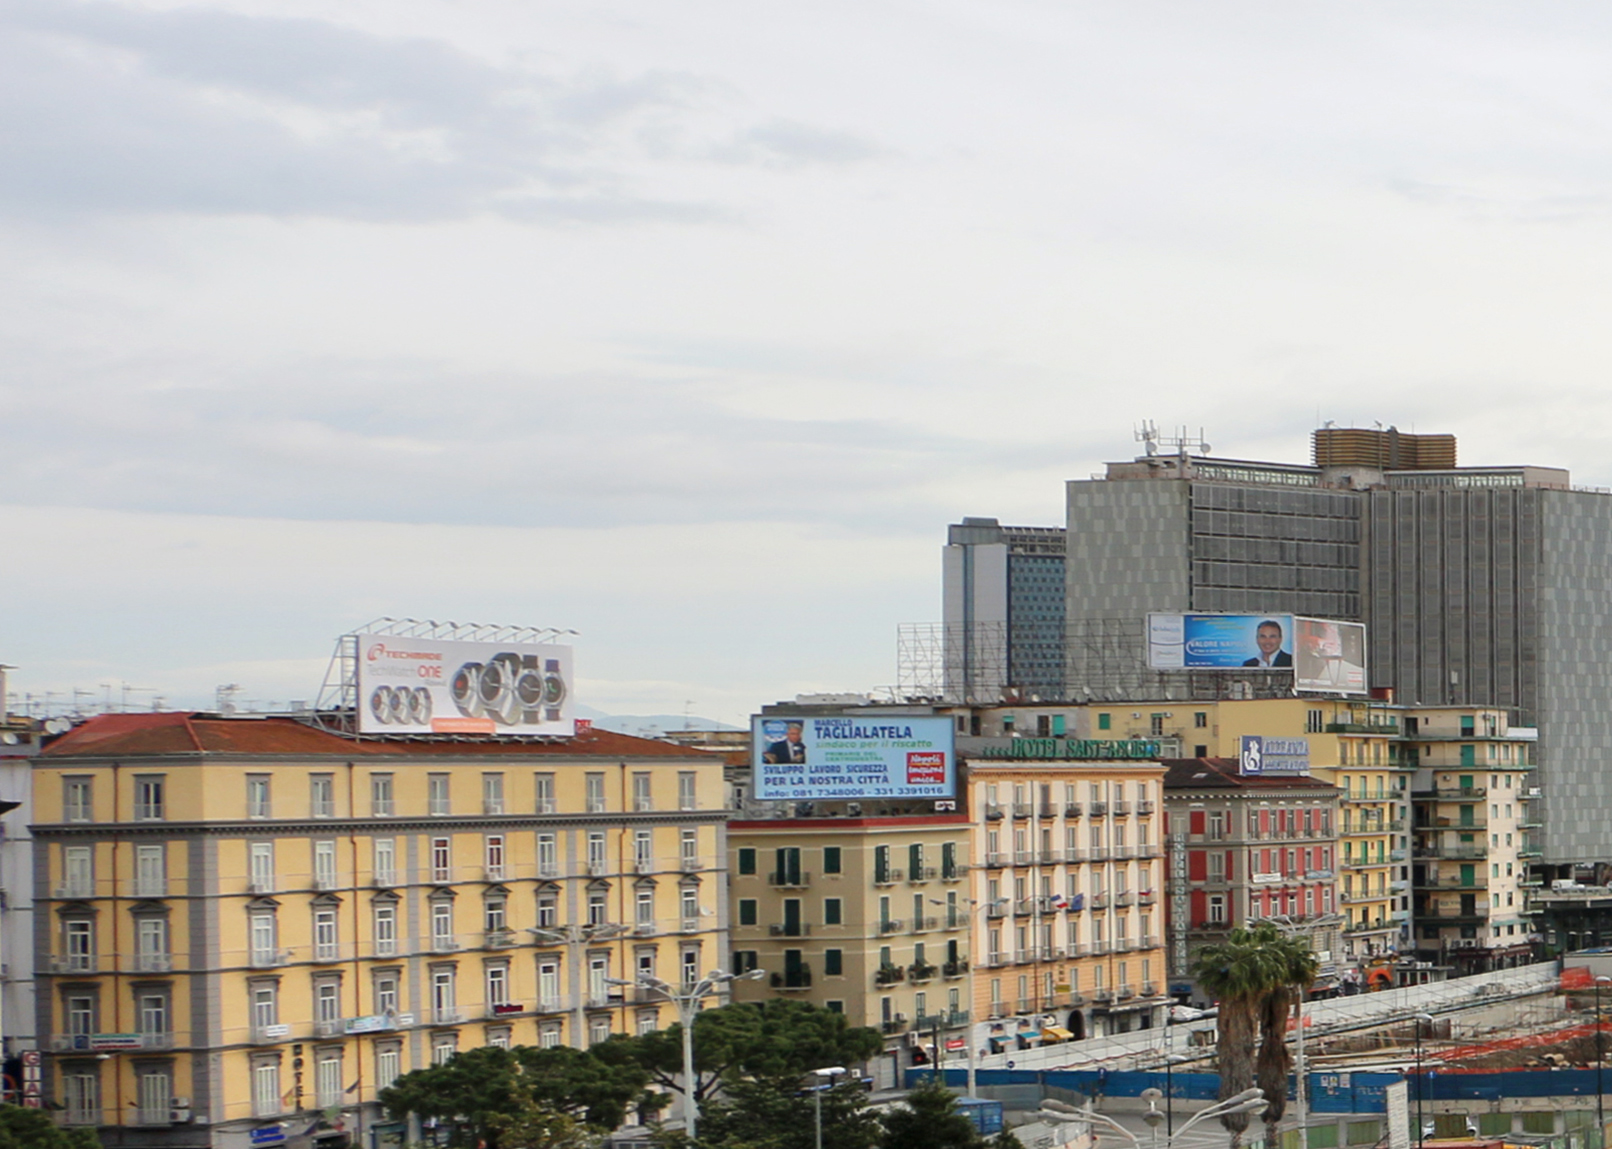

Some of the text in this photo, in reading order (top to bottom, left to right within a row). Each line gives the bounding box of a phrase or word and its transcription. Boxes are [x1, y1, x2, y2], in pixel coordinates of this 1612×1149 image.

[814, 726, 912, 739] TAGLIALATELA
[816, 741, 857, 749] sindaco
[860, 741, 878, 750] per
[891, 739, 933, 748] riscatto
[1012, 738, 1057, 758] HOTEL
[764, 764, 888, 775] SVILUPPO LAVORO SICUREZZA
[764, 773, 889, 786] PER LA NOSTRA CITTÀ
[792, 789, 813, 797] 081
[897, 787, 944, 795] 3391016
